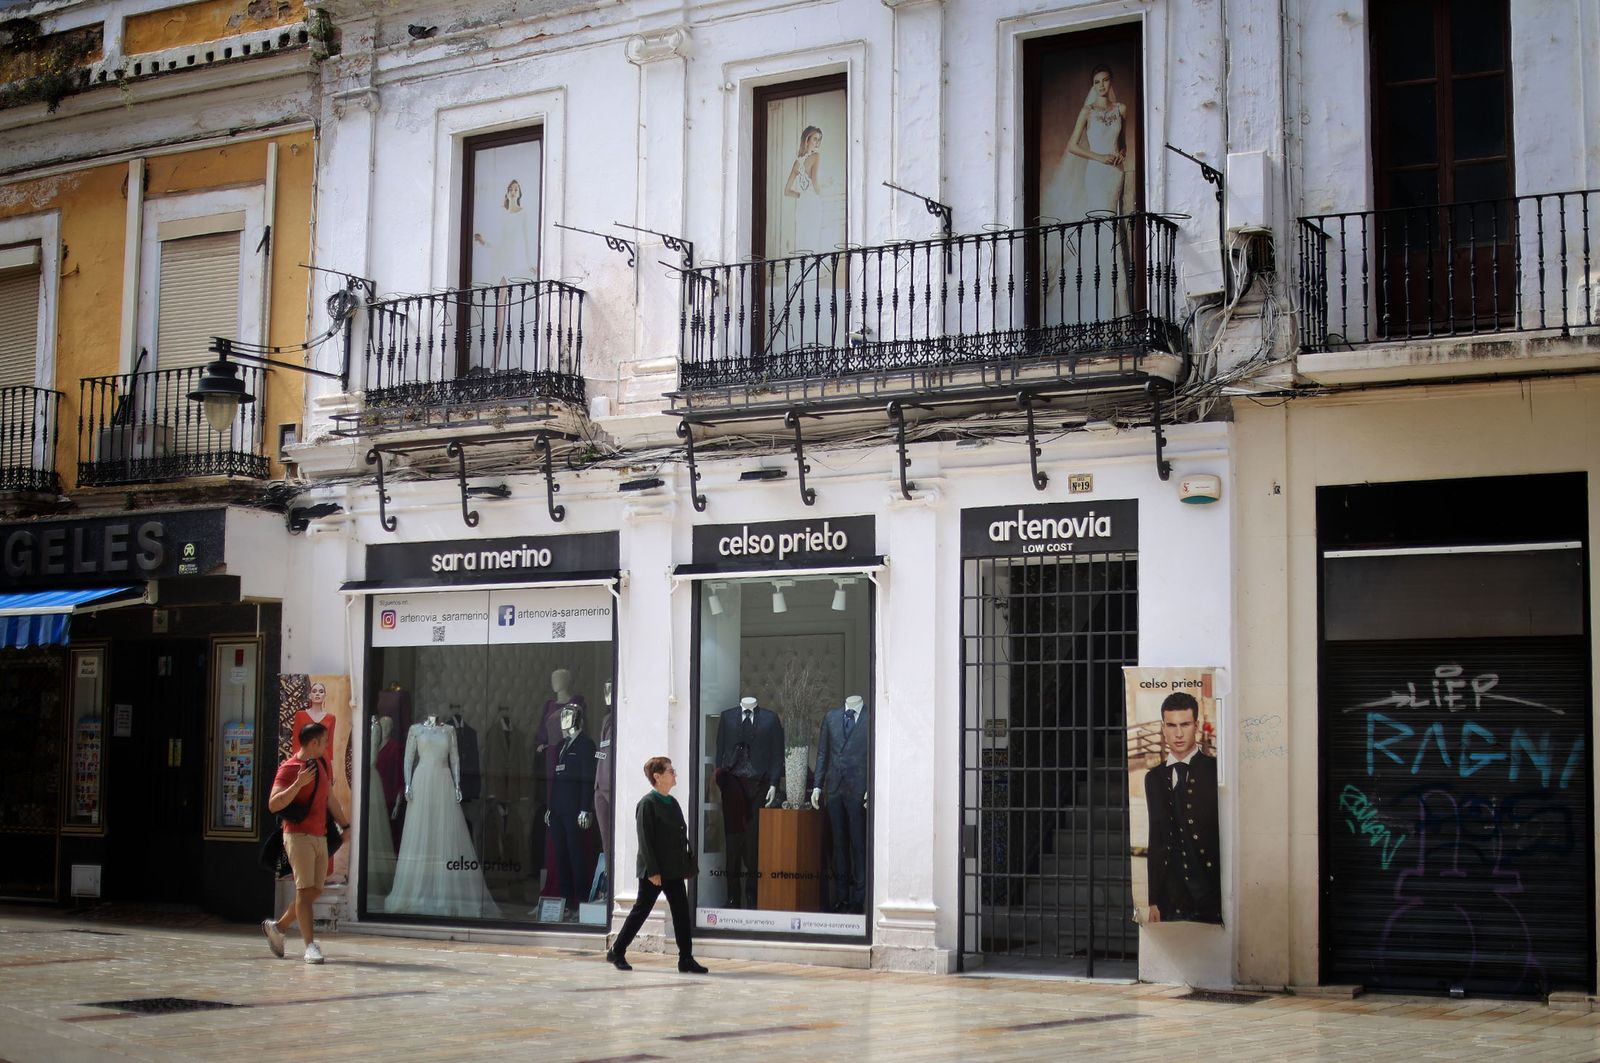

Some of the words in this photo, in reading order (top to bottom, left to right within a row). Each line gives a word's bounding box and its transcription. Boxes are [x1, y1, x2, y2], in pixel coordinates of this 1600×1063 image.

[988, 509, 1112, 542] artenovia
[4, 521, 164, 577] GELES
[718, 525, 775, 556] celso
[778, 521, 848, 561] prieto
[1022, 544, 1045, 553] LOW
[1046, 542, 1073, 552] COST
[431, 551, 477, 573] sara
[480, 544, 552, 571] merino
[518, 606, 610, 619] artenovia-saramerino
[1139, 678, 1168, 689] celso
[1171, 678, 1203, 691] prieto
[446, 855, 478, 871] celso
